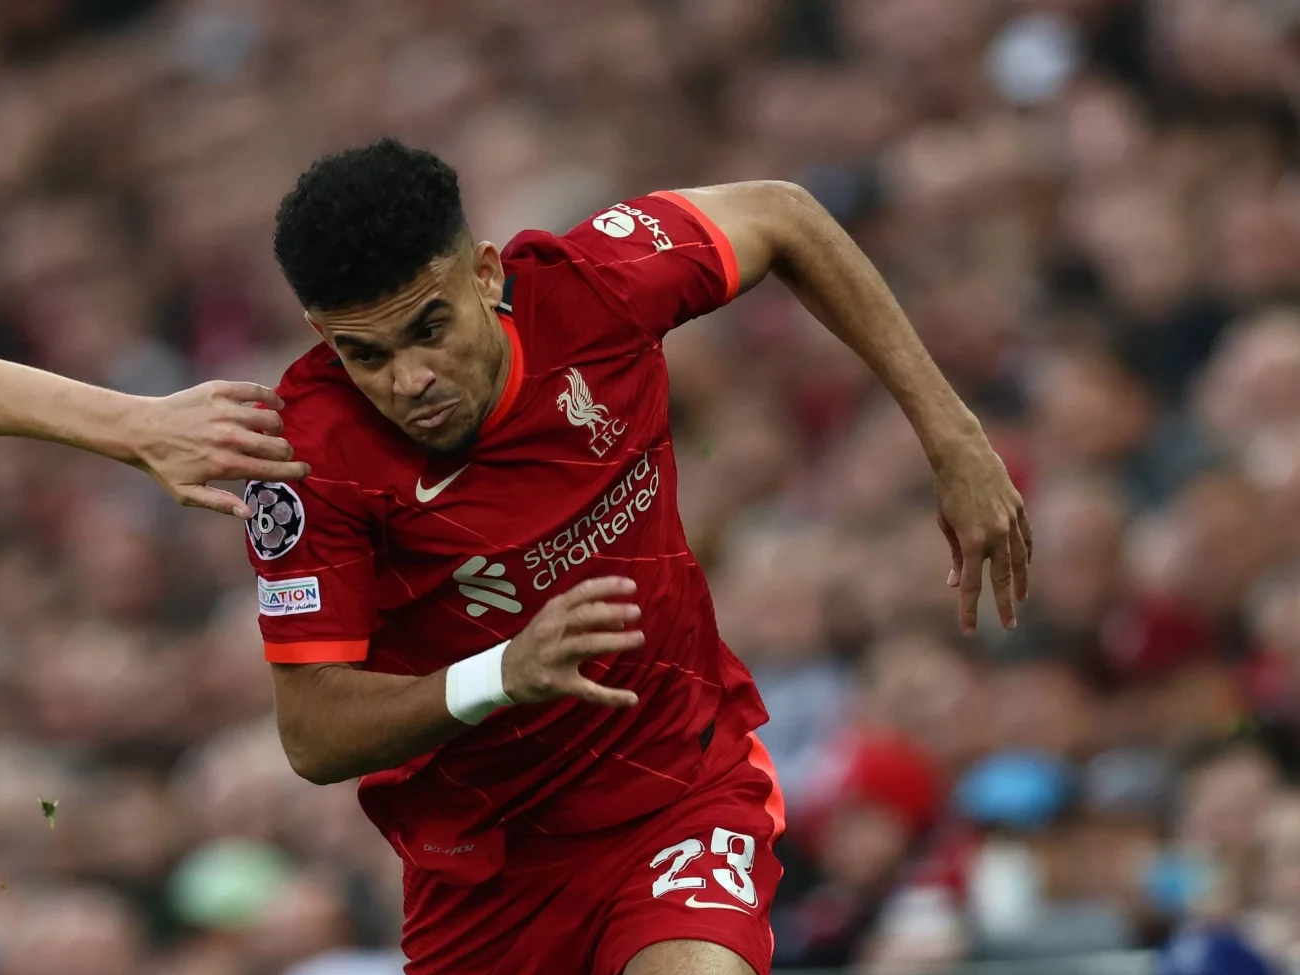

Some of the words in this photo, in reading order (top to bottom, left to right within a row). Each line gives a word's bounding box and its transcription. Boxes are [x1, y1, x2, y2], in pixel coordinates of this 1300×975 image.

[258, 504, 275, 534] 6
[524, 451, 650, 569] standard
[532, 465, 659, 591] chartered
[649, 826, 758, 909] 23
